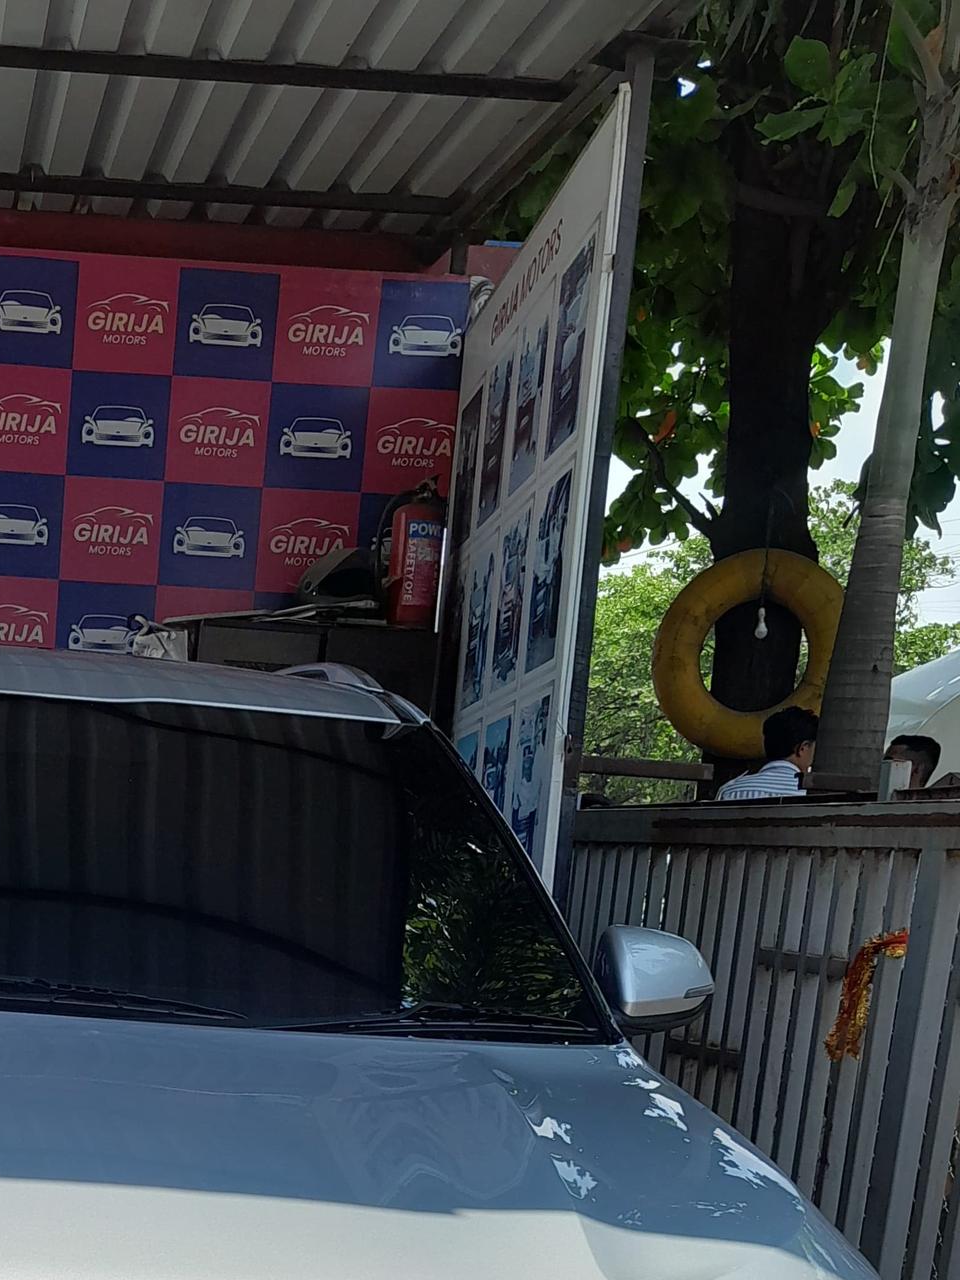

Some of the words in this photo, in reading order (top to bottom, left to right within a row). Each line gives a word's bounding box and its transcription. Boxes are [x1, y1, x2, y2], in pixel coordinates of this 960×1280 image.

[87, 310, 164, 334] GIRIJA
[102, 333, 147, 346] MOTORS
[287, 322, 364, 346] GIRIJA
[302, 345, 347, 357] MOTORS
[179, 424, 256, 447] GIRIJA
[194, 446, 238, 459] MOTORS
[376, 434, 451, 458] GIRIJA
[391, 457, 435, 469] MOTORS
[73, 522, 150, 545] GIRIJA
[88, 544, 132, 556] MOTORS
[270, 534, 344, 556] GIRIJA
[284, 556, 319, 566] MOTO
